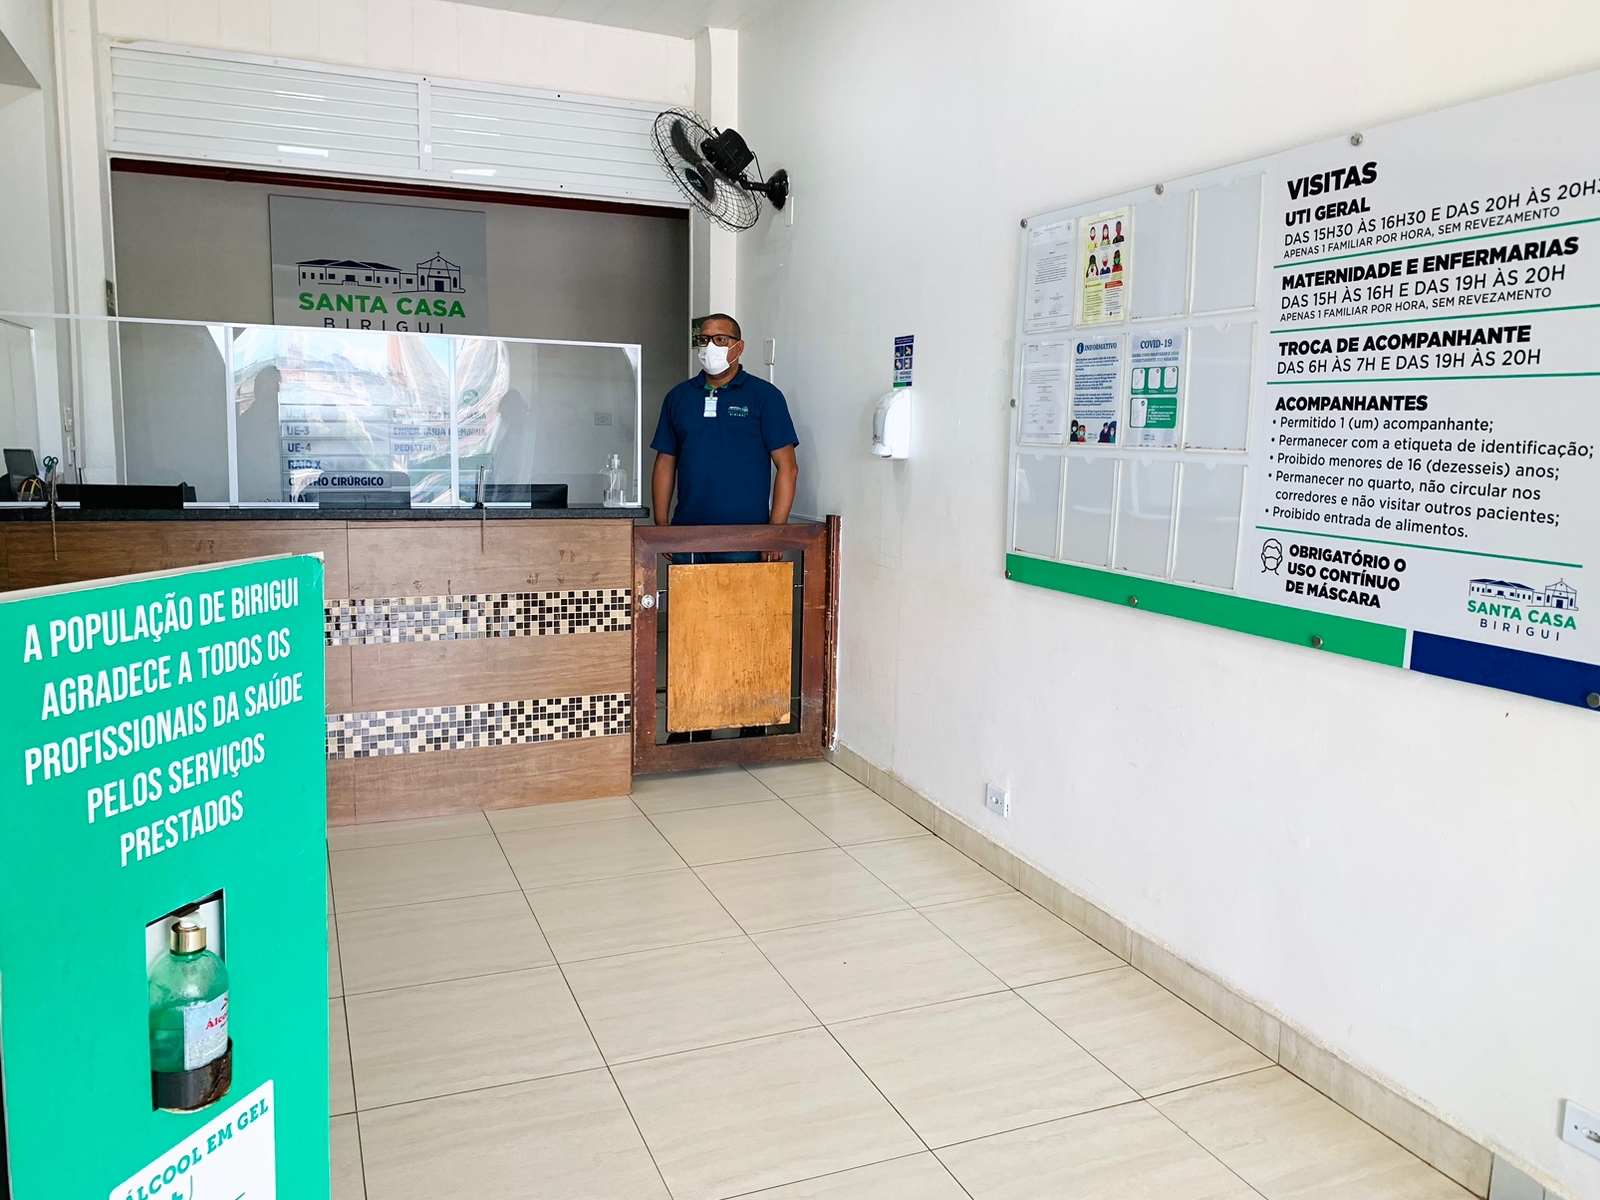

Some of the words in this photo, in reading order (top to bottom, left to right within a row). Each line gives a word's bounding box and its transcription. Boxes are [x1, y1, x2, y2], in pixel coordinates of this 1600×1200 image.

[1287, 161, 1377, 200] VISITAS
[1284, 233, 1310, 246] DAS
[1314, 224, 1354, 242] 15H30
[1357, 217, 1377, 234] ÀS
[1381, 211, 1426, 229] 16H30
[1432, 208, 1440, 221] E
[1446, 201, 1480, 219] DAS
[1485, 193, 1520, 213] 20H
[1528, 186, 1551, 205] ÀS
[1285, 208, 1312, 226] UTI
[1315, 197, 1371, 221] GERAL
[1284, 246, 1318, 259] APENAS
[1321, 244, 1325, 252] 1
[1328, 237, 1373, 251] FAMILIAR
[1376, 232, 1397, 244] POR
[1401, 227, 1435, 241] HORA,
[1438, 223, 1461, 236] SEM
[1464, 206, 1560, 232] REVEZAMENTO
[1282, 261, 1402, 290] MATERNIDADE
[1406, 259, 1418, 274] E
[1423, 236, 1579, 273] ENFERMARIAS
[1281, 295, 1308, 310] DAS
[1313, 291, 1337, 306] 15H
[1342, 286, 1362, 303] ÀS
[1366, 285, 1393, 300] 16H
[1400, 282, 1408, 296] E
[1415, 278, 1449, 295] DAS
[1455, 274, 1486, 291] 19H
[1493, 267, 1518, 287] ÀS
[1525, 265, 1565, 282] 20H
[299, 292, 388, 313] SANTA
[396, 298, 466, 318] CASA
[1280, 311, 1316, 322] APENAS
[1318, 310, 1321, 318] 1
[1325, 305, 1368, 318] FAMILIAR
[1371, 303, 1391, 313] POR
[1395, 300, 1428, 312] HORA,
[1432, 297, 1455, 308] SEM
[1458, 287, 1551, 306] REVEZAMENTO
[324, 318, 444, 334] BIRIGUI
[1279, 340, 1332, 356] TROCA
[1337, 337, 1359, 353] DE
[1362, 325, 1531, 352] ACOMPANHANTE
[1140, 339, 1172, 349] COVID-19
[1277, 361, 1304, 374] DAS
[1308, 359, 1327, 373] 6H
[1332, 355, 1351, 372] ÀS
[1356, 356, 1375, 372] 7H
[1382, 356, 1390, 370] E
[1396, 354, 1429, 369] DAS
[1435, 352, 1464, 369] 19H
[1472, 348, 1495, 367] ÀS
[1502, 349, 1541, 366] 20H
[1275, 395, 1428, 411] ACOMPANHANTES
[287, 426, 310, 436] UE-3
[1280, 416, 1336, 429] Permitido
[1340, 418, 1344, 429] 1
[1349, 417, 1379, 431] (um)
[1383, 417, 1493, 433] acompanhante;
[288, 444, 312, 452] UE-4
[1279, 435, 1348, 448] Permanecer
[1351, 439, 1378, 449] com
[1382, 440, 1390, 449] a
[1394, 439, 1452, 453] etiqueta
[1457, 440, 1476, 452] de
[1481, 440, 1593, 459] identificação;
[331, 475, 384, 486] CIRÚRGICO
[1277, 453, 1325, 466] Proibido
[1329, 457, 1382, 470] menores
[1386, 457, 1403, 470] de
[1408, 459, 1421, 471] 16
[1426, 459, 1510, 477] (dezesseis)
[1516, 465, 1559, 481] anos;
[1276, 471, 1344, 486] Permanecer
[1348, 477, 1364, 488] no
[1367, 476, 1414, 493] quarto,
[1419, 480, 1445, 493] não
[1450, 482, 1507, 497] circular
[1512, 486, 1541, 500] nos
[1272, 506, 1320, 522] Proibido
[1324, 512, 1371, 527] entrada
[1375, 515, 1391, 529] de
[1395, 516, 1468, 538] alimentos.
[1275, 489, 1337, 504] corredores
[1341, 496, 1348, 505] e
[1352, 495, 1375, 508] não
[1379, 497, 1420, 512] visitar
[1424, 500, 1471, 517] outros
[1476, 505, 1559, 527] pacientes;
[1289, 544, 1390, 570] OBRIGATÓRIO
[1394, 559, 1406, 572] O
[1287, 562, 1316, 578] USO
[1319, 567, 1400, 592] CONTÍNUO
[1285, 580, 1304, 595] DE
[1307, 581, 1381, 608] MÁSCARA
[23, 624, 42, 663] A
[50, 592, 193, 658] POPULAÇÃO
[199, 590, 226, 626] DE
[232, 577, 299, 620] BIRIGUI
[1467, 600, 1523, 621] SANTA
[1528, 610, 1577, 630] CASA
[1480, 619, 1560, 641] BIRIGUI
[41, 655, 171, 720] AGRADECE
[177, 651, 192, 685] A
[197, 634, 263, 679] TODOS
[267, 628, 291, 662] OS
[24, 700, 207, 786] PROFISSIONAIS
[213, 692, 240, 727] DA
[244, 672, 303, 718] SAÚDE
[87, 768, 163, 824] PELOS
[168, 733, 266, 794] SERVIÇOS
[120, 790, 244, 868] PRESTADOS
[207, 1123, 233, 1154] EM
[237, 1098, 269, 1130] GEL
